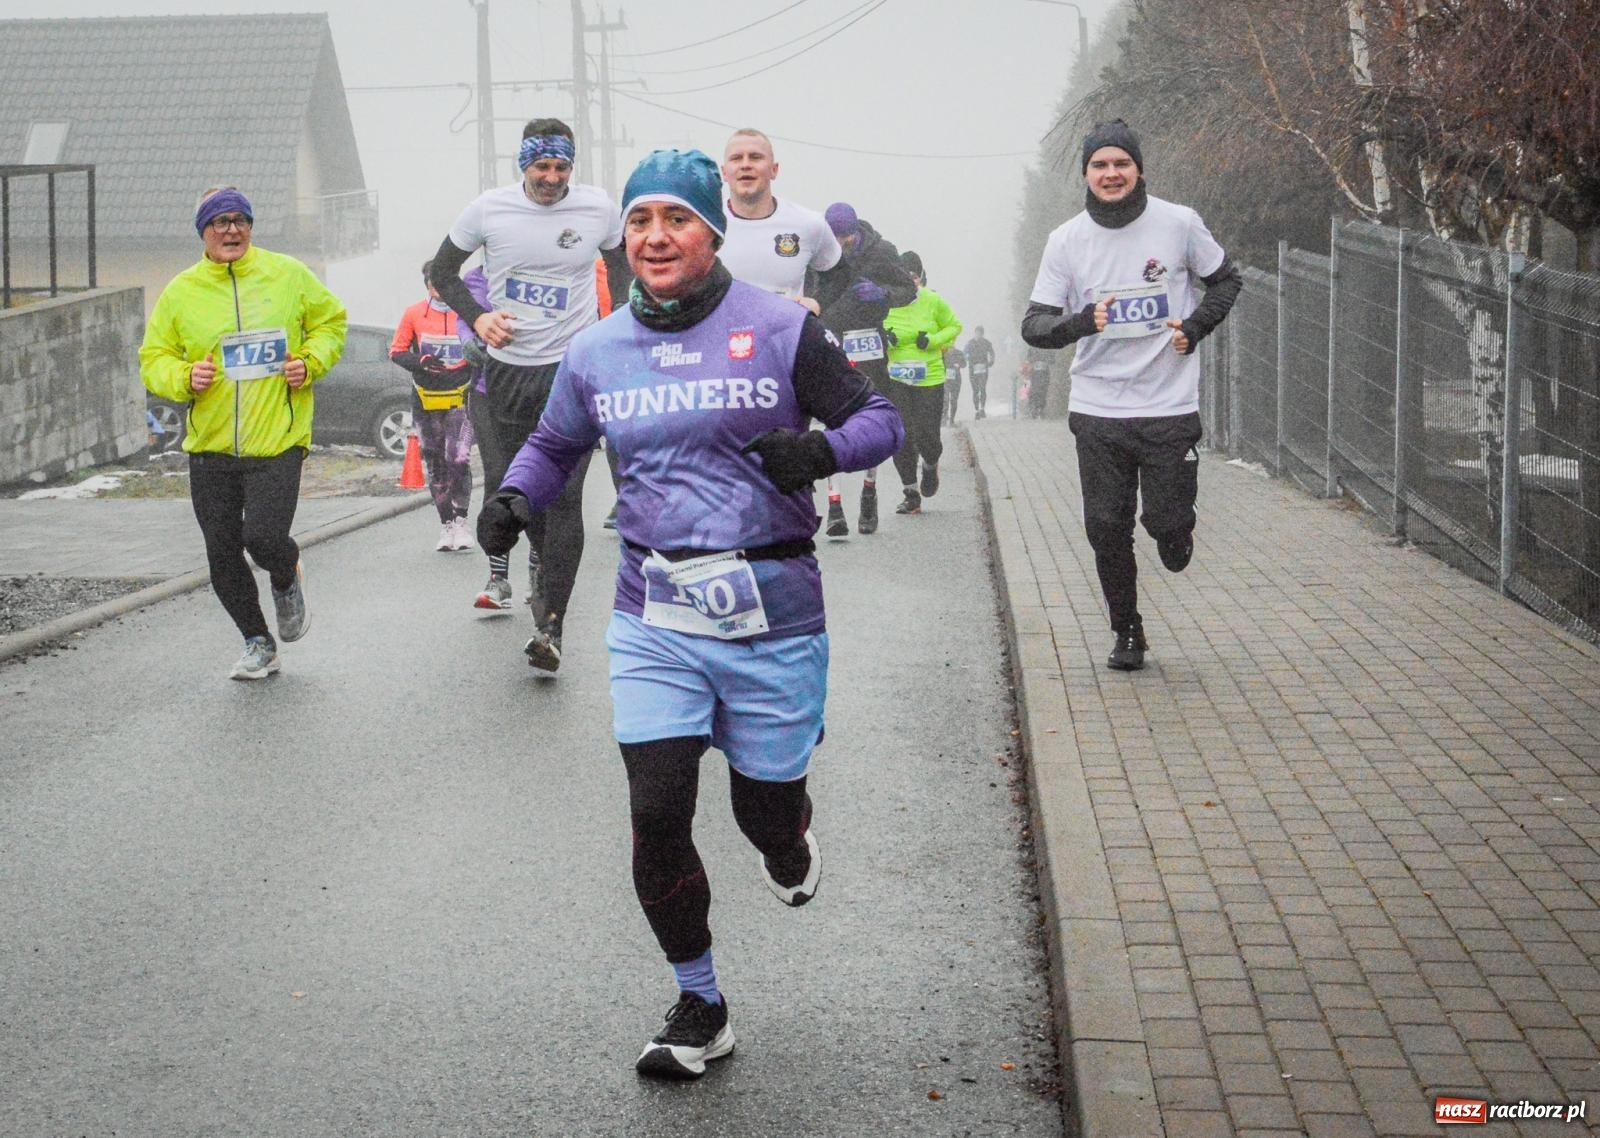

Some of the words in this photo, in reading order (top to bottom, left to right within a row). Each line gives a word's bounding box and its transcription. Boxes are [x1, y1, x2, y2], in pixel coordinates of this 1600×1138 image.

[516, 283, 557, 308] 136
[1110, 297, 1159, 323] 160
[234, 341, 277, 366] 175
[432, 344, 451, 358] 71
[851, 337, 877, 352] 158
[899, 368, 916, 379] 20
[594, 377, 779, 423] RUNNERS
